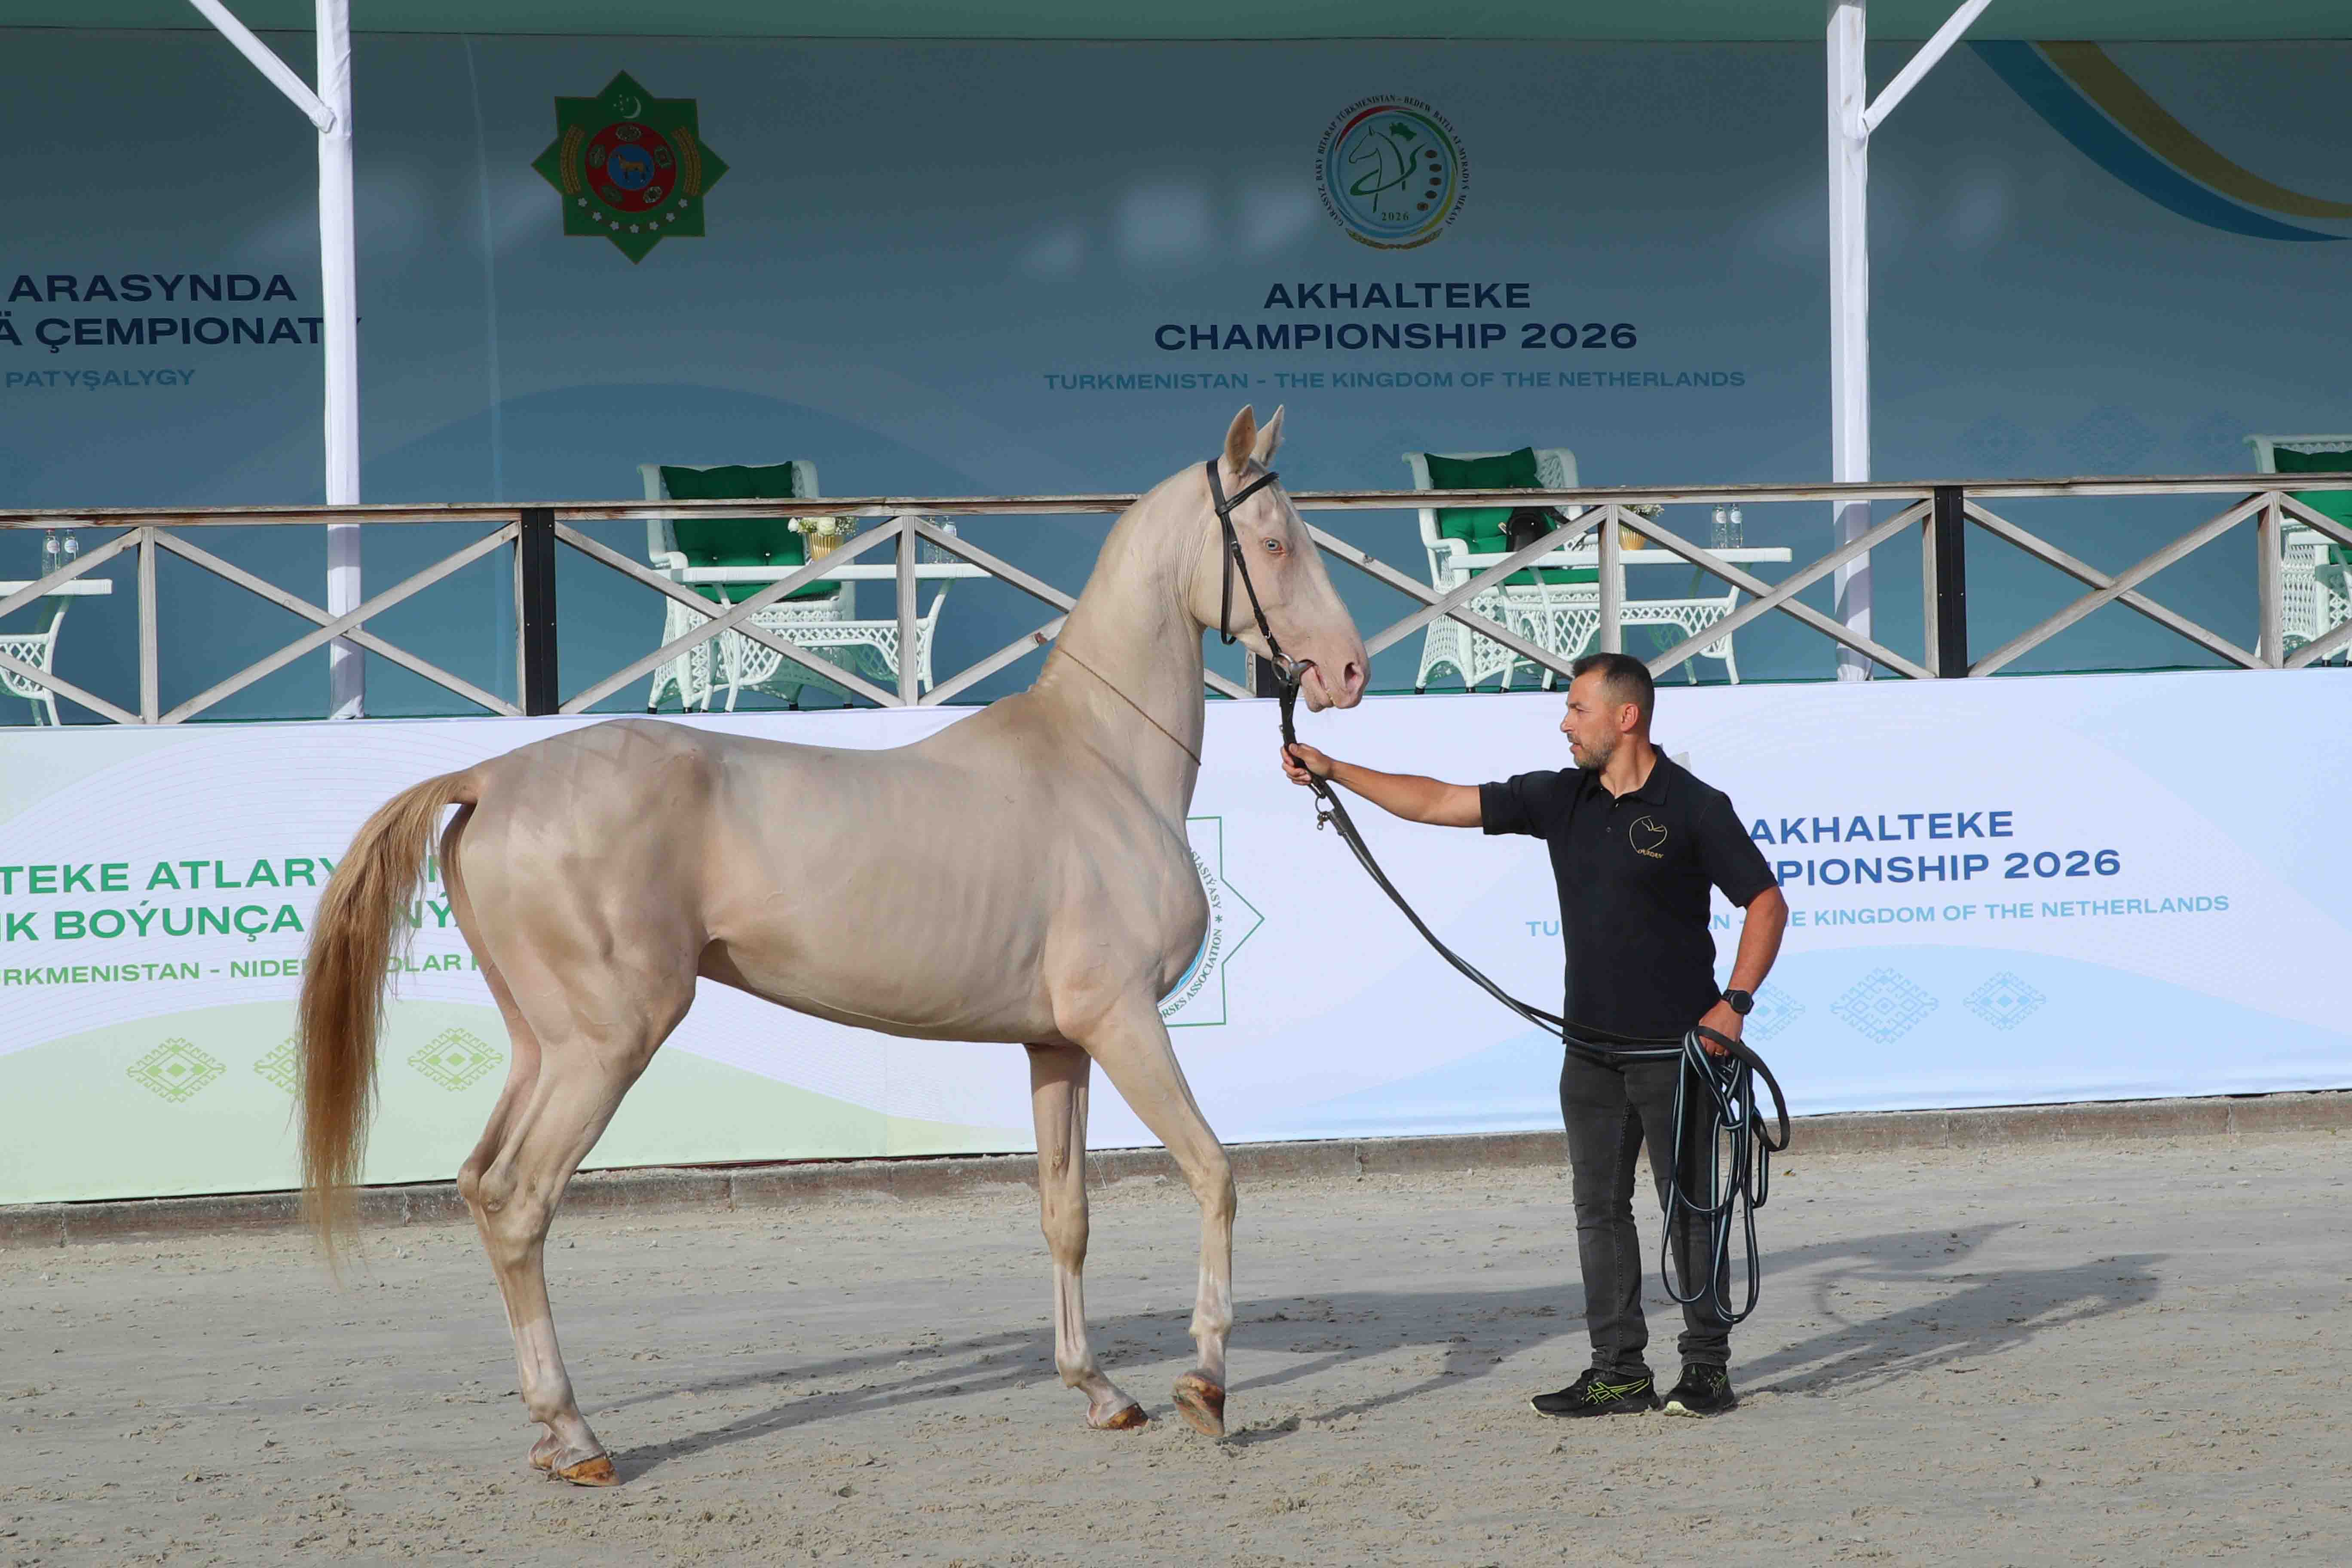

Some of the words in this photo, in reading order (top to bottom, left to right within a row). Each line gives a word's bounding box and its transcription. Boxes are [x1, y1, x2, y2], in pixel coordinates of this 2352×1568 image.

[1381, 212, 1410, 221] 2026
[8, 274, 297, 302] ARASYNDA
[1264, 283, 1530, 309] AKHALTEKE
[36, 317, 361, 354] ÇEMPIONAT
[1155, 324, 1506, 350] CHAMPIONSHIP
[1522, 323, 1637, 349] 2026
[6, 369, 196, 392] PATYŞALYGY
[1043, 373, 1248, 390] TURKMENISTAN
[1274, 372, 1324, 389] THE
[1332, 372, 1453, 389] KINGDOM
[1460, 371, 1494, 388] OF
[1501, 371, 1551, 388] THE
[1559, 371, 1746, 388] NETHERLANDS
[1748, 812, 2012, 845] AKHALTEKE
[0, 862, 131, 895] TEKE
[1770, 854, 1988, 888] PIONSHIP
[2005, 849, 2120, 879] 2026
[55, 900, 304, 942] BOÝUNÇA
[1815, 907, 1935, 926] KINGDOM
[1942, 905, 1976, 921] OF
[1984, 902, 2034, 919] THE
[2042, 895, 2229, 917] NETHERLANDS
[0, 962, 200, 984] RKMENISTAN
[1161, 997, 1187, 1020] RSES
[1187, 928, 1222, 999] ASSOCIATION
